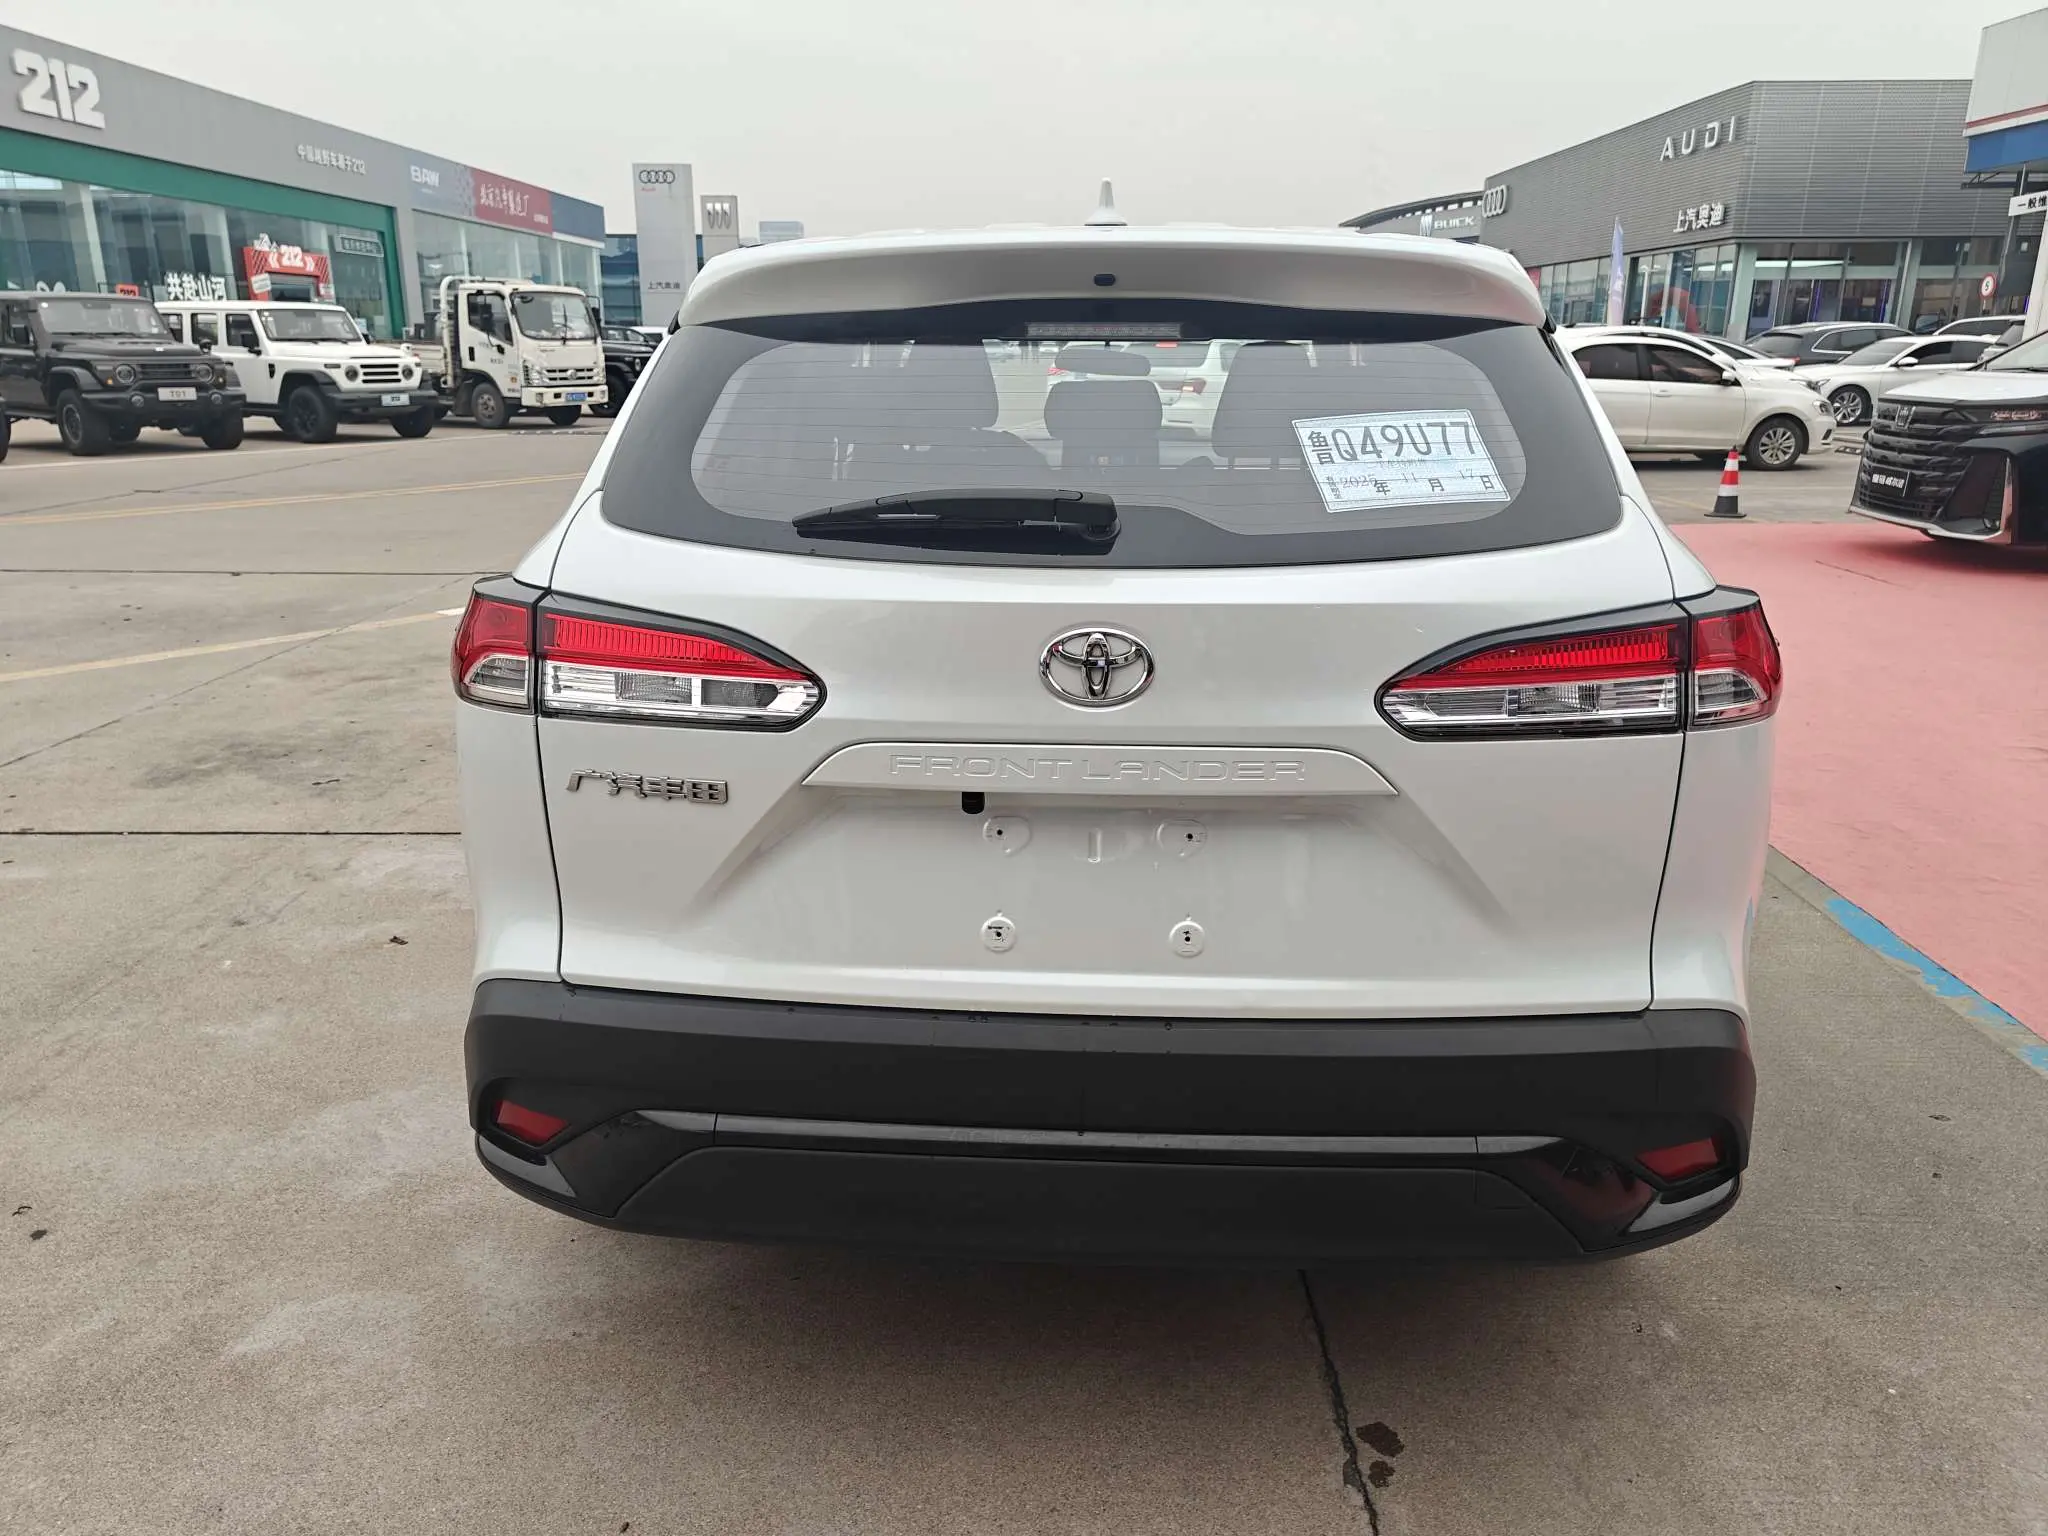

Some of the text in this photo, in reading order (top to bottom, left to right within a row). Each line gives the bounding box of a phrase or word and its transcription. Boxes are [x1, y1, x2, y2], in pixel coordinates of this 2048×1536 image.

[12, 48, 105, 128] 212
[1660, 116, 1735, 160] AUDI
[410, 165, 440, 187] BAW
[1434, 216, 1474, 229] BUICK
[1673, 202, 1725, 232] 上汽奥迪
[280, 244, 304, 268] 212
[1308, 421, 1476, 465] 鲁Q49U77
[566, 768, 728, 805] 广汽丰田
